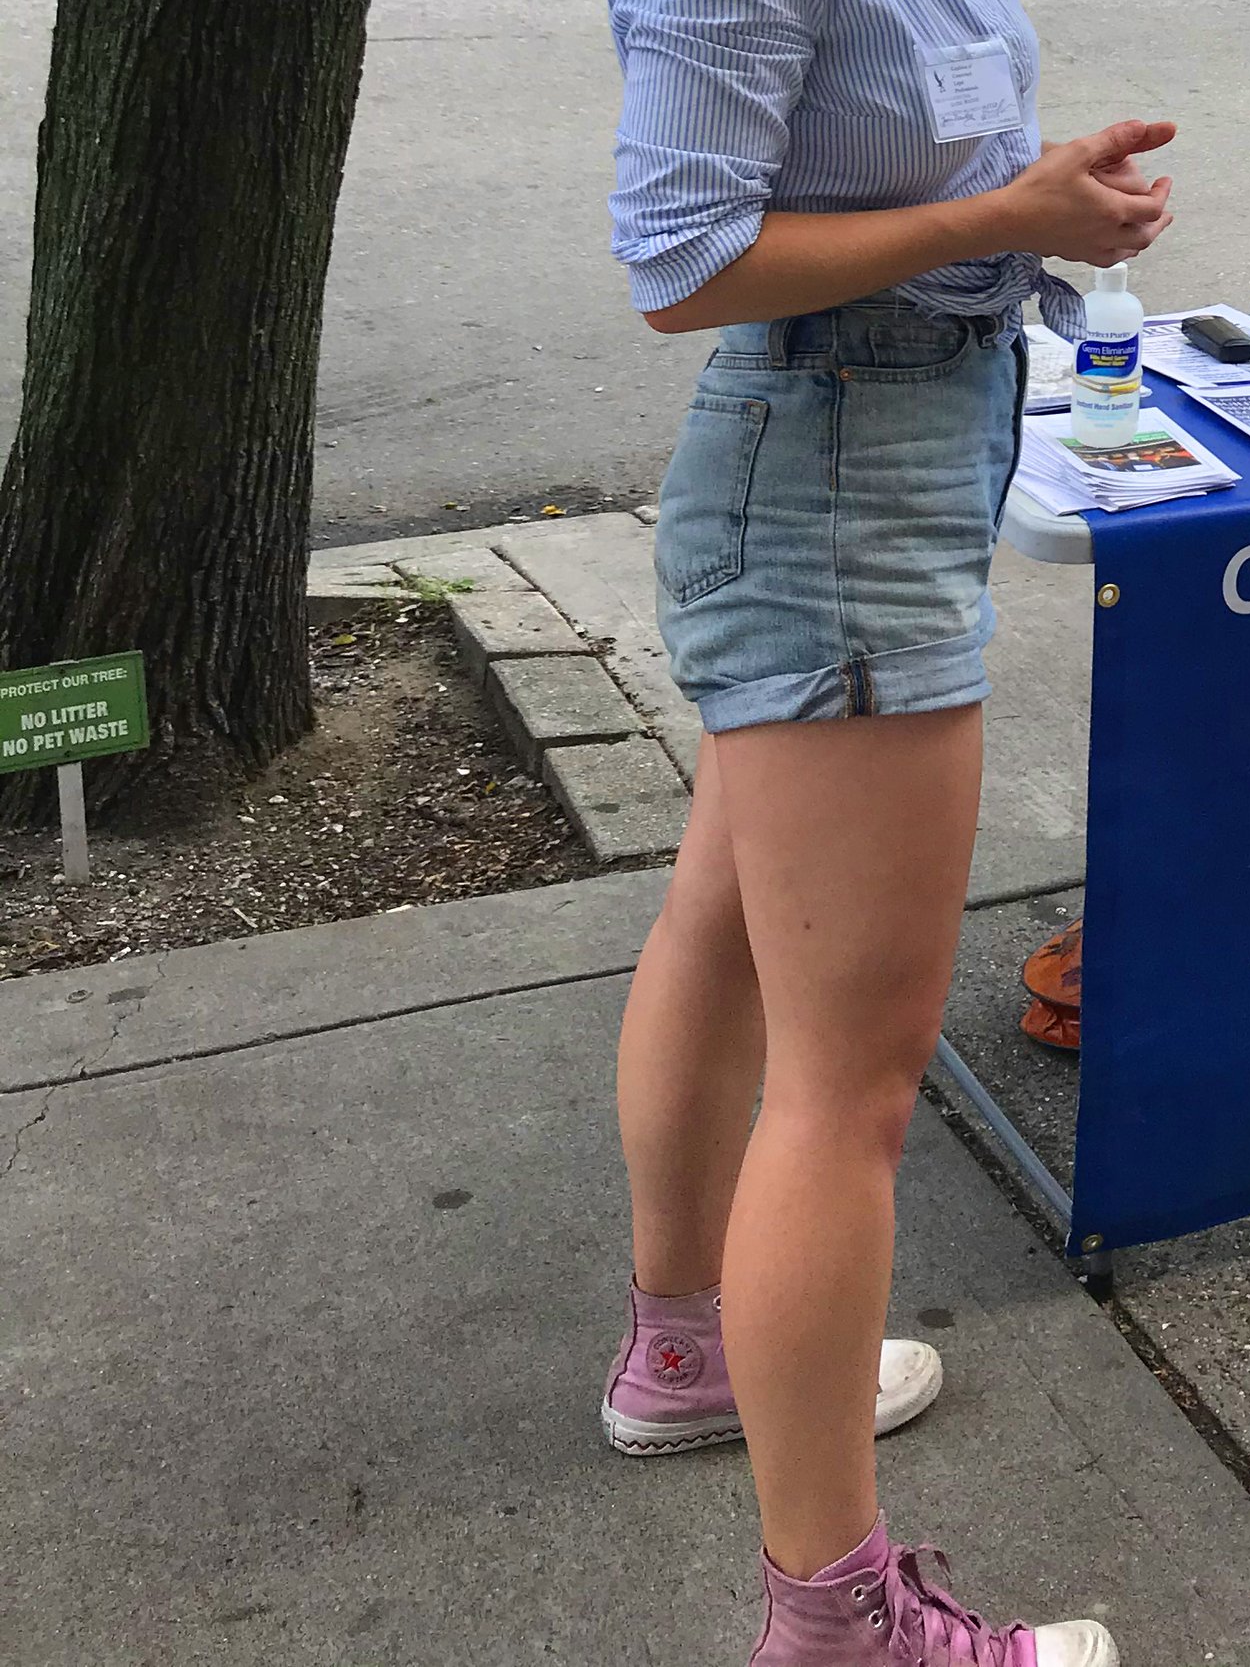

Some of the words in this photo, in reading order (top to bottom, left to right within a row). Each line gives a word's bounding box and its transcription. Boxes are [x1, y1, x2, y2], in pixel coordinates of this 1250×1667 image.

[1082, 343, 1101, 354] Germ
[1101, 345, 1137, 355] Eliminator
[1, 679, 59, 699] PROTECT
[62, 674, 89, 689] OUR
[21, 711, 47, 731] NO
[51, 701, 108, 725] LITTER
[3, 739, 28, 757] NO
[33, 731, 65, 751] PET
[69, 720, 128, 744] WASTE
